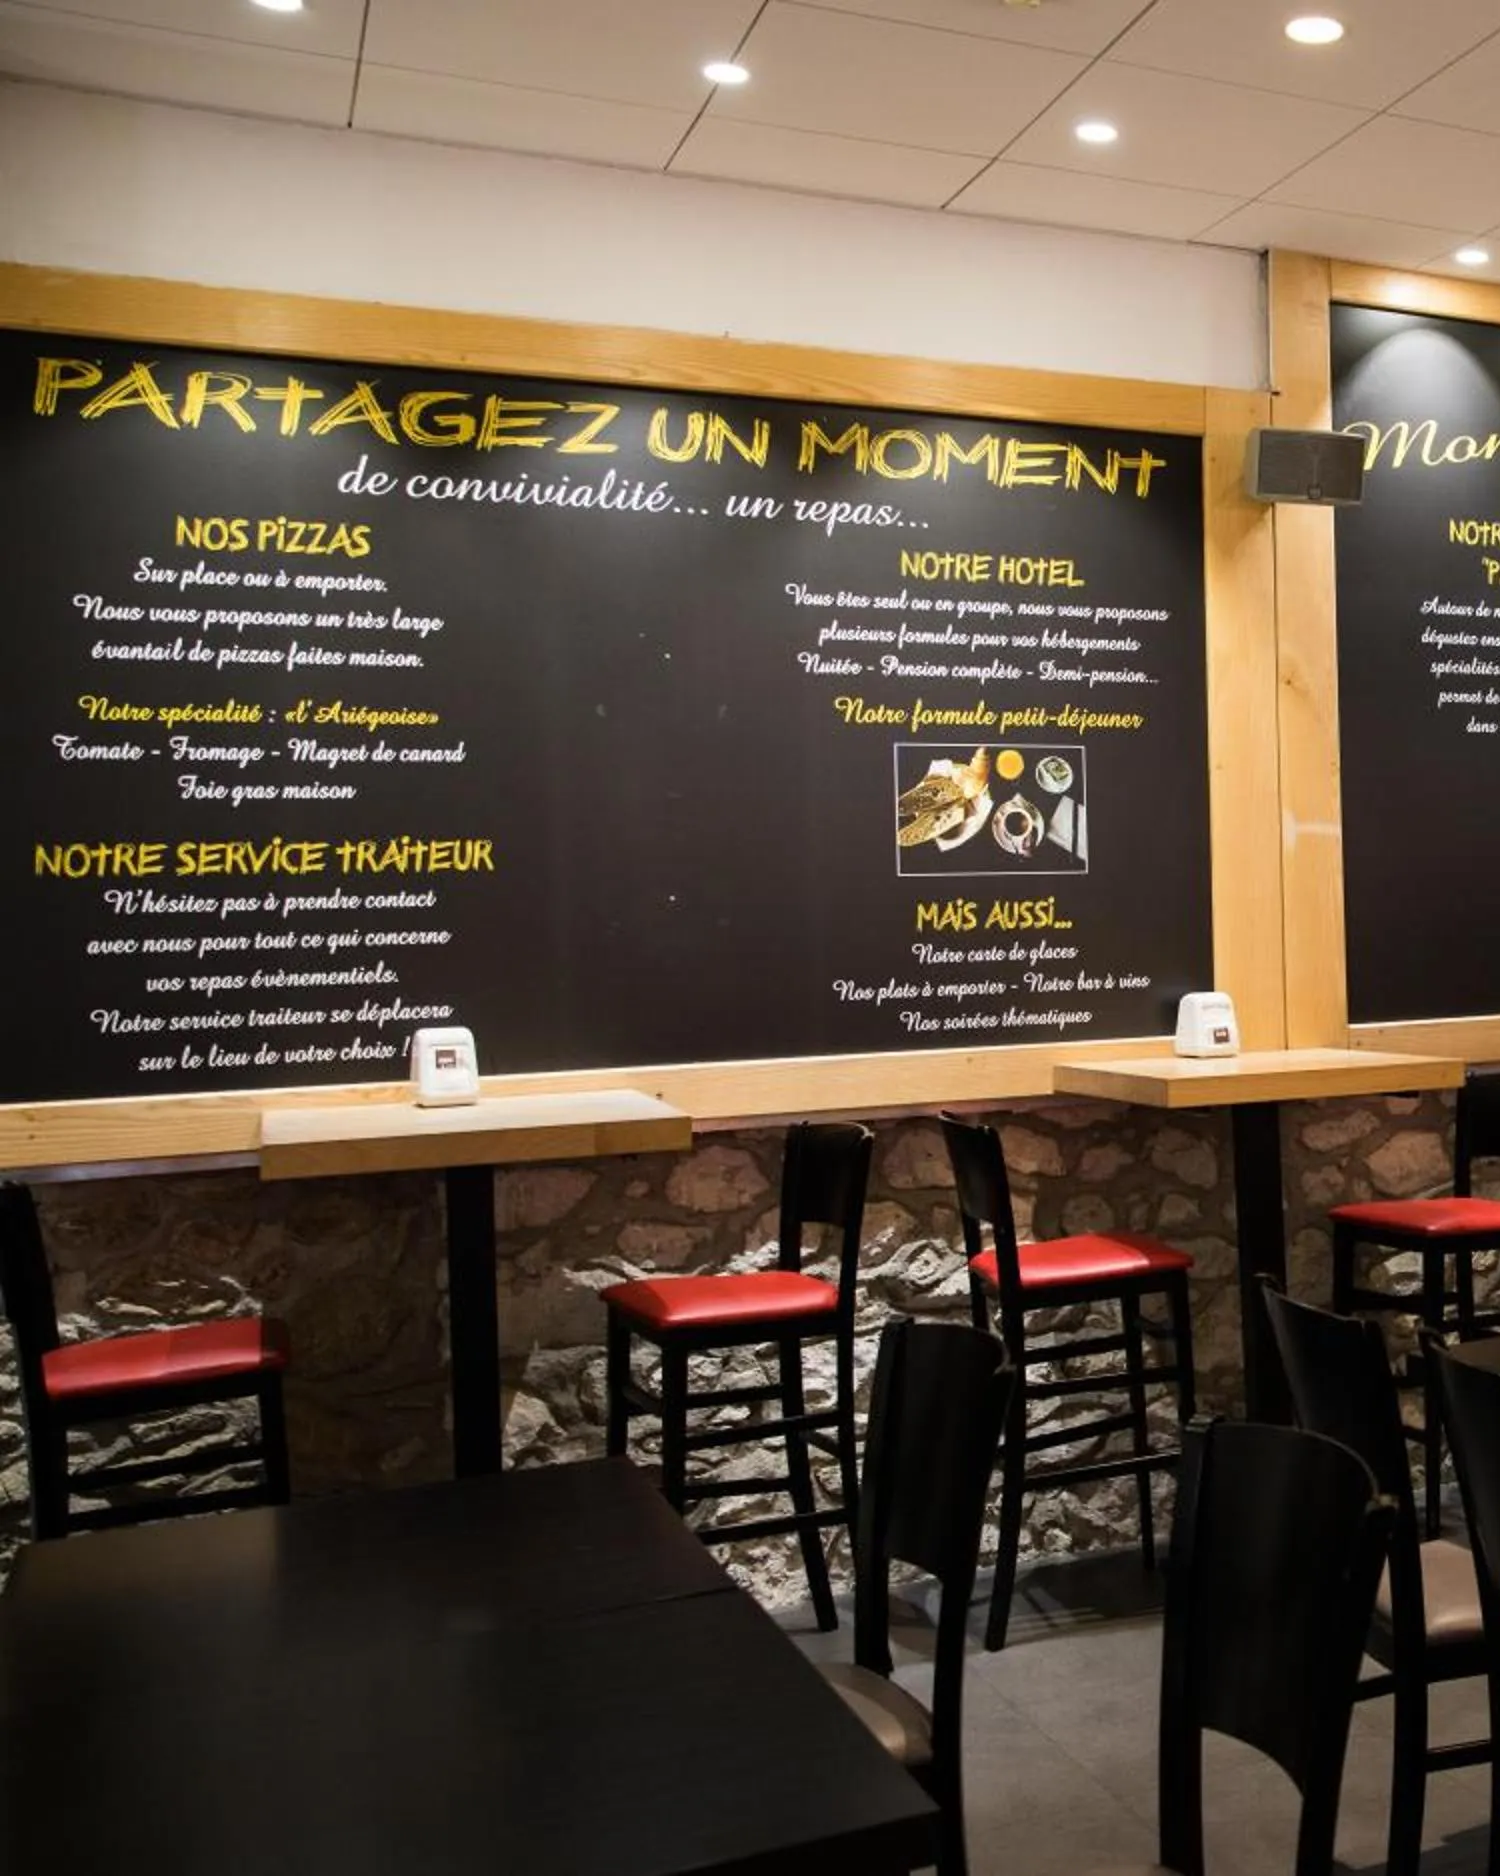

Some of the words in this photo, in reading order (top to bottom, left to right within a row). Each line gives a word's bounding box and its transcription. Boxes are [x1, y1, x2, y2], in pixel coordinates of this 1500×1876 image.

[33, 356, 621, 454] PARTAGEZ
[644, 408, 768, 467] UN
[799, 422, 1165, 496] MOMENT
[338, 455, 398, 495] de
[406, 467, 708, 514] convivialité...
[726, 496, 783, 518] un
[794, 500, 928, 535] repas...
[176, 516, 248, 551] NOS
[134, 558, 181, 590] Sur
[180, 561, 240, 590] place
[243, 573, 276, 587] ou
[274, 570, 291, 587] à
[294, 574, 387, 594] emporter.
[901, 551, 992, 582] NOTRE
[998, 556, 1084, 587] HOTEL
[73, 594, 144, 620] Nous
[150, 608, 201, 622] vous
[204, 610, 312, 632] proposons
[315, 614, 344, 627] un
[347, 611, 388, 628] très
[392, 607, 444, 638] large
[785, 584, 837, 606] Vous
[836, 591, 870, 608] êtes
[873, 589, 908, 609] seul
[911, 599, 932, 610] ou
[935, 600, 954, 611] en
[957, 601, 1013, 619] groupe,
[1018, 604, 1055, 616] nous
[1058, 606, 1093, 617] vous
[1092, 608, 1168, 625] proposons
[1421, 596, 1477, 616] Autour
[1473, 600, 1492, 617] de
[818, 620, 899, 647] plusieurs
[898, 623, 973, 652] formules
[969, 634, 1008, 652] pour
[1012, 636, 1038, 647] vos
[1041, 628, 1140, 656] hébergements
[1422, 626, 1478, 650] dégustez
[92, 640, 185, 660] évantail
[188, 640, 215, 662] de
[217, 645, 288, 670] pizzas
[287, 644, 346, 671] faites
[349, 649, 423, 667] maison.
[798, 652, 862, 674] Nuitée
[880, 655, 953, 676] Pension
[952, 659, 1022, 684] complète
[79, 696, 154, 720] Notre
[158, 699, 262, 728] spécialité
[835, 697, 908, 723] Notre
[912, 699, 997, 732] formule
[1000, 704, 1143, 734] petit-déjeuner
[52, 734, 144, 760] Tomate
[170, 736, 264, 768] Fromage
[288, 738, 369, 768] Magret
[371, 740, 396, 762] de
[399, 742, 466, 762] canard
[178, 775, 228, 799] Foie
[231, 786, 279, 807] gras
[282, 782, 356, 799] maison
[36, 843, 168, 877] NOTRE
[104, 889, 222, 918] N'hésitez
[221, 898, 261, 919] pas
[263, 893, 280, 910] à
[283, 888, 362, 918] prendre
[365, 891, 436, 908] contact
[87, 940, 138, 954] avec
[142, 938, 196, 952] nous
[199, 937, 251, 958] pour
[255, 932, 297, 949] tout
[301, 935, 324, 948] ce
[327, 930, 362, 954] qui
[365, 931, 451, 946] concerne
[912, 944, 965, 964] Notre
[968, 947, 1006, 962] carte
[1008, 942, 1028, 960] de
[1030, 940, 1078, 966] glaces
[147, 978, 185, 992] vos
[190, 976, 248, 997] repas
[833, 980, 878, 1005] Nos
[877, 978, 920, 1005] plats
[922, 981, 934, 996] à
[938, 980, 1006, 1002] emporter
[1024, 972, 1074, 992] Notre
[1078, 970, 1102, 990] bar
[1104, 974, 1116, 989] à
[1119, 974, 1150, 988] vins
[90, 1010, 166, 1033] Notre
[169, 1011, 244, 1030] service
[249, 1008, 326, 1026] traiteur
[330, 1010, 354, 1023] se
[356, 998, 453, 1027] déplacera
[900, 1012, 940, 1031] Nos
[944, 1013, 1003, 1029] soirées
[1002, 1007, 1092, 1030] thématiques
[139, 1056, 176, 1071] sur
[181, 1045, 204, 1068] le
[209, 1044, 250, 1067] lieu
[254, 1043, 280, 1064] de
[285, 1045, 336, 1063] votre
[340, 1037, 396, 1060] choix
